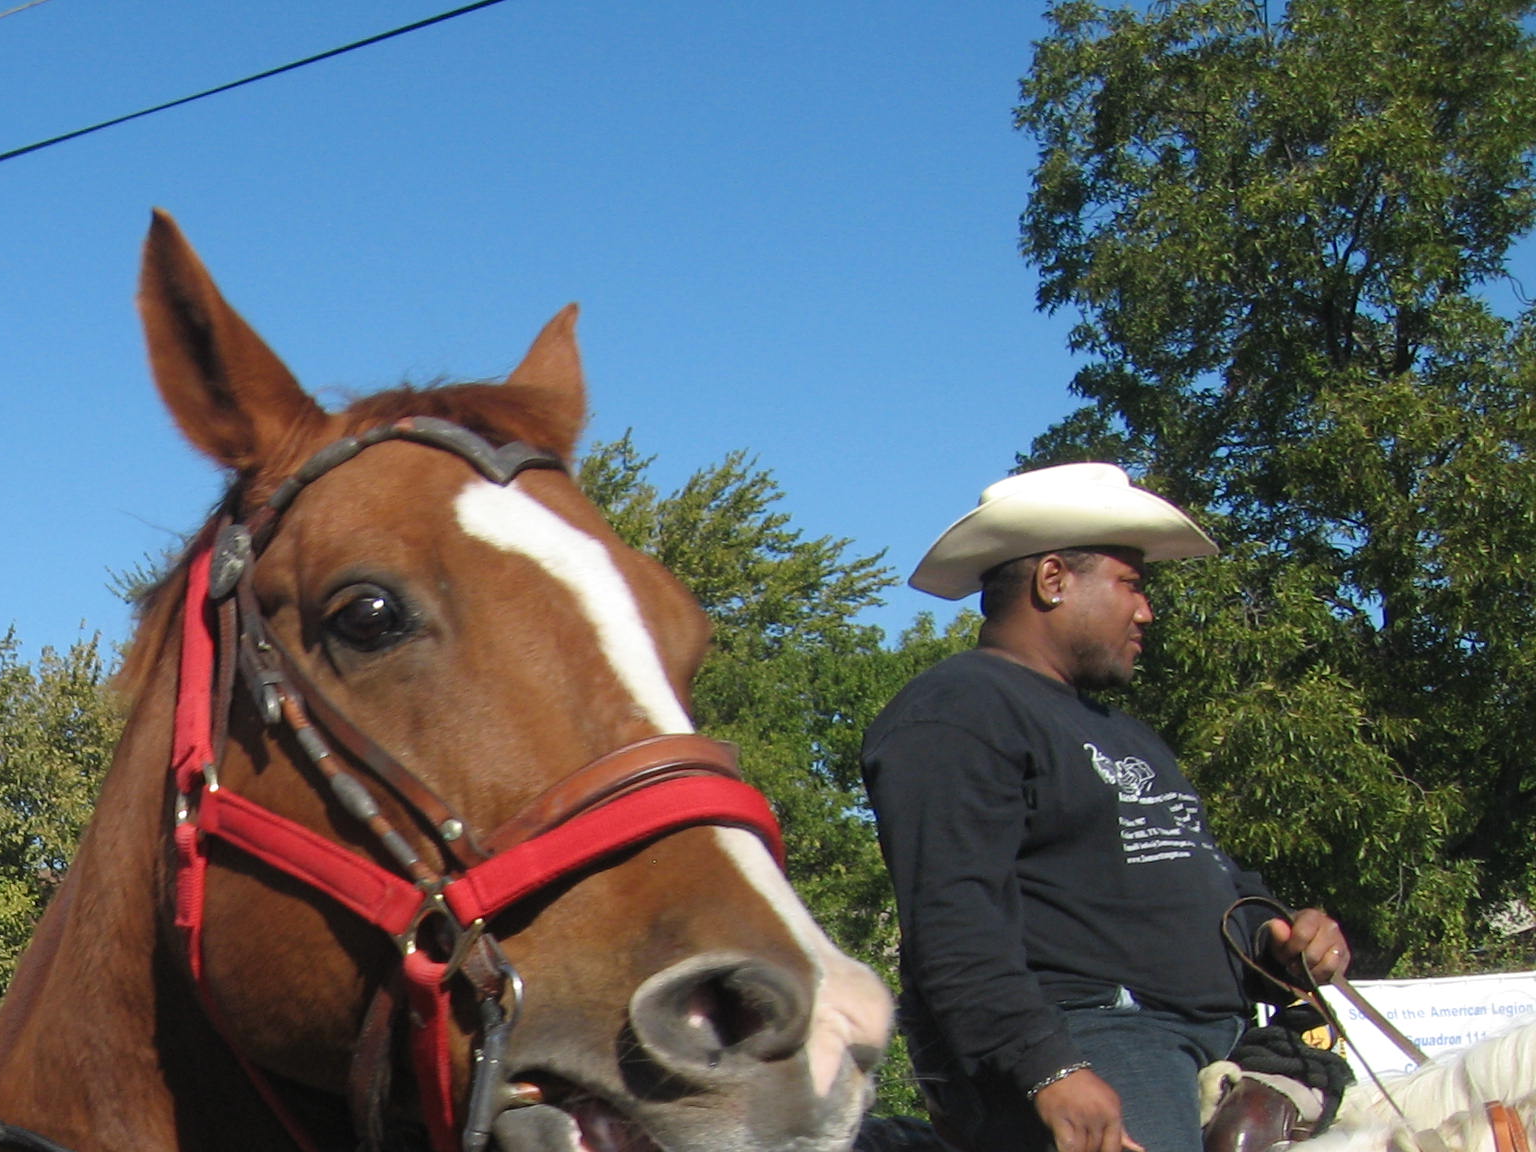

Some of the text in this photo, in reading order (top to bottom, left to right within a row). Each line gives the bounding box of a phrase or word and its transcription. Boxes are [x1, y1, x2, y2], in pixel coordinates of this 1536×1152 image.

[1402, 1009, 1425, 1020] the
[1430, 1005, 1487, 1018] American
[1491, 1001, 1534, 1017] Legion
